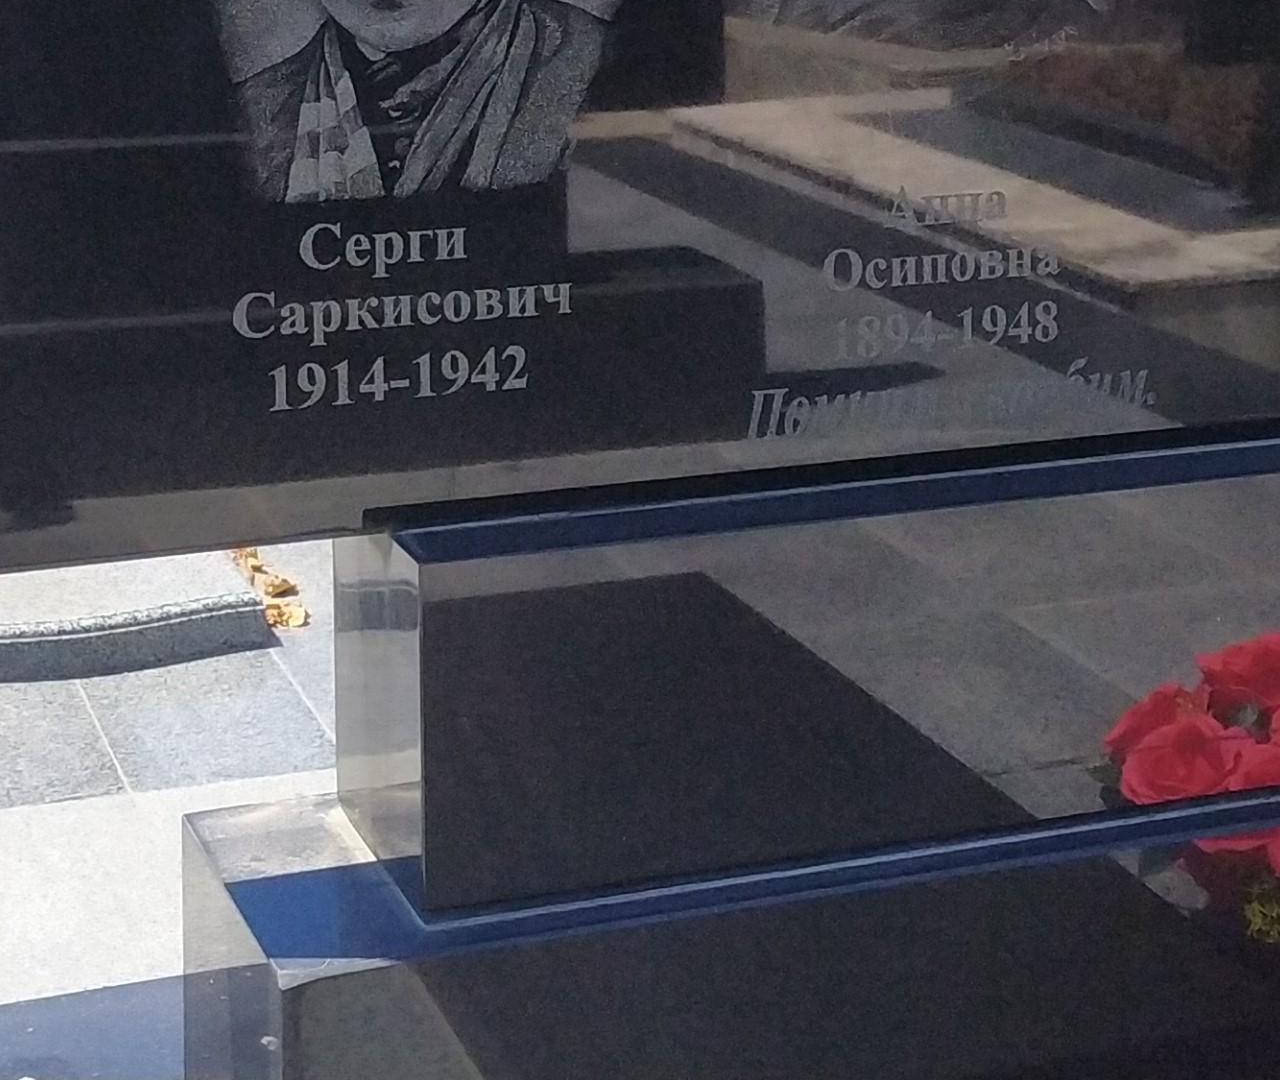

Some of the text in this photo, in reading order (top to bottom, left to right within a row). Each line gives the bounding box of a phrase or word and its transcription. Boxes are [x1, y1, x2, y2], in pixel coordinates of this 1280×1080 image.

[884, 185, 1008, 229] Анна
[298, 222, 468, 279] Серги
[823, 246, 1061, 292] Осиповна
[232, 282, 573, 348] Саркисович
[835, 301, 1060, 361] 1894-1948
[268, 345, 529, 413] 1914-1942
